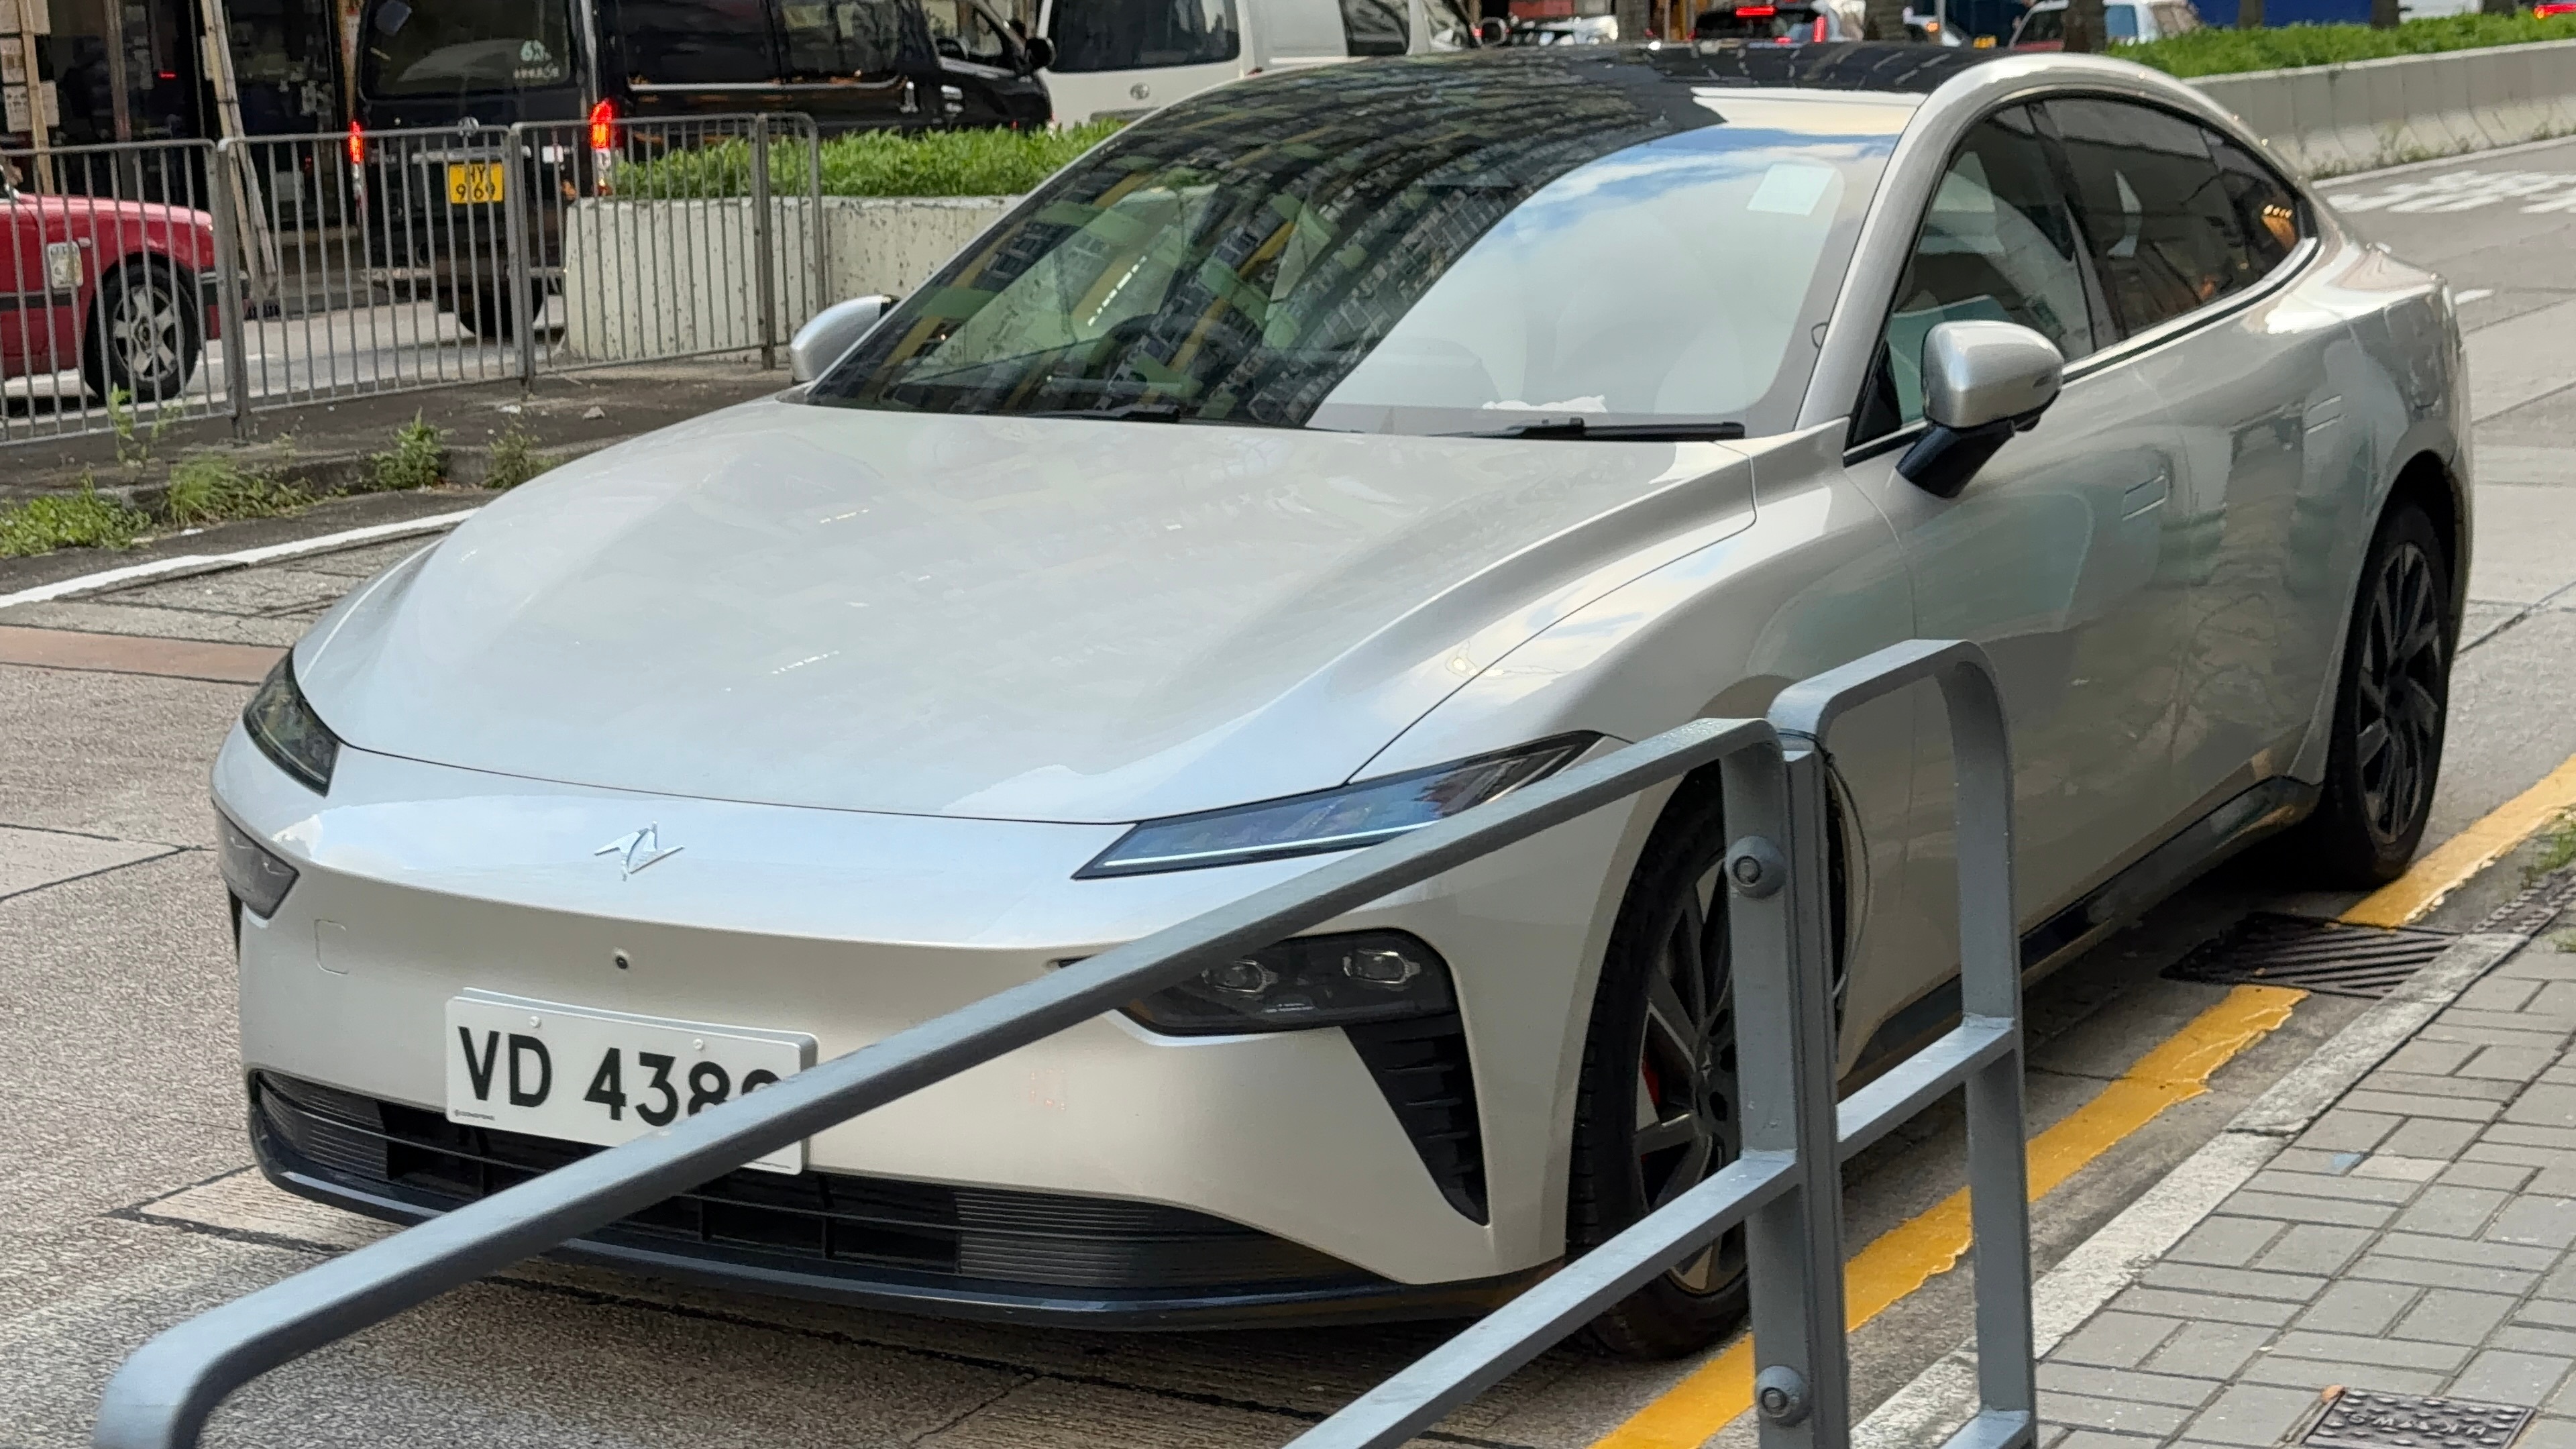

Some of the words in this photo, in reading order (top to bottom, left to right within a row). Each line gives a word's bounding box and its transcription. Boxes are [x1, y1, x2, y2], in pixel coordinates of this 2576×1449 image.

[456, 182, 496, 201] 969
[458, 1025, 552, 1108] VD
[582, 1046, 782, 1127] 438
